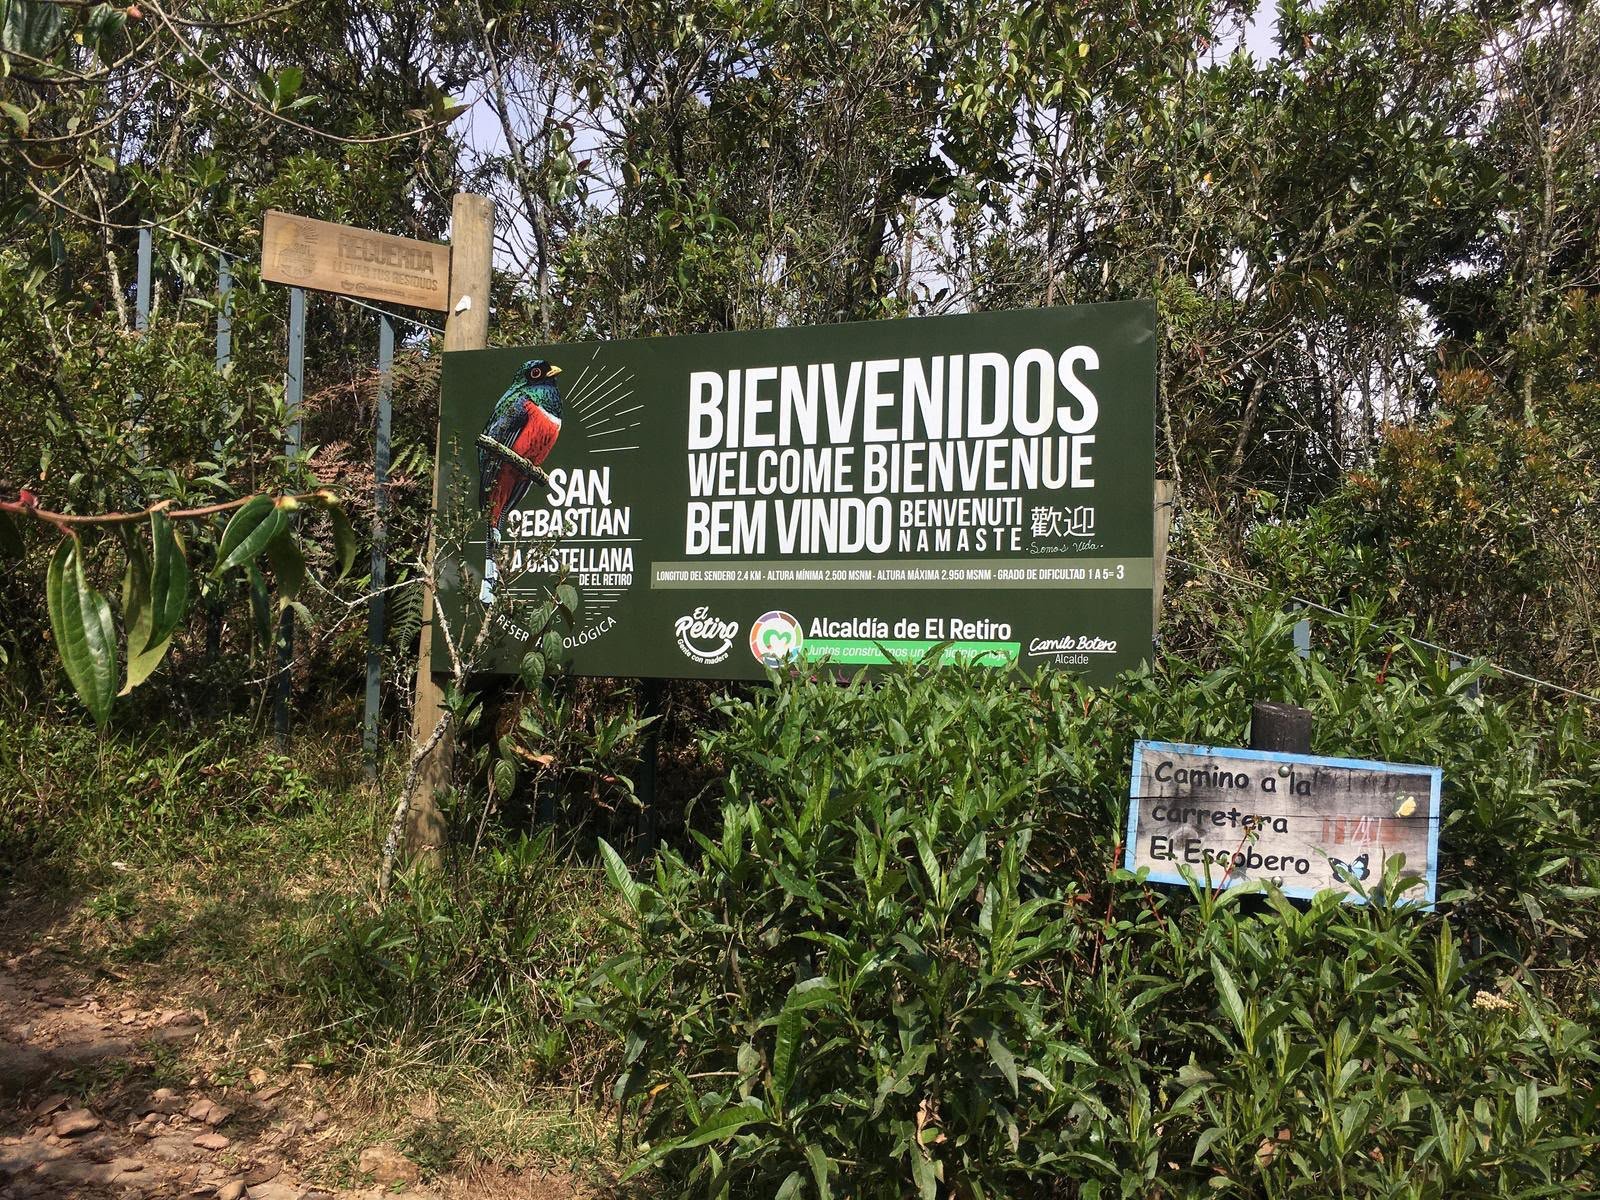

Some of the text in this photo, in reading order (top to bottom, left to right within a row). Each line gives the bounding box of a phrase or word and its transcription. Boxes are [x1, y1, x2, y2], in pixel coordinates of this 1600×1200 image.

[338, 234, 433, 274] RECUERDA
[392, 271, 438, 291] RESIDUOS
[688, 345, 1100, 450] BIENVENIDOS
[687, 435, 1096, 497] WELCOME BIENVENUE
[546, 466, 611, 507] SAN
[685, 496, 892, 555] BEM VINDO
[899, 497, 1023, 528] BENVENUTI
[1030, 505, 1096, 537] 歡迎
[898, 528, 1022, 553] NAMASTE
[579, 573, 632, 586] DE EL RETIRO
[656, 570, 689, 581] LONGITUD
[690, 570, 703, 581] DEL
[704, 570, 736, 581] SENDERO
[736, 570, 749, 581] 2.4
[750, 570, 761, 581] KM
[767, 569, 794, 581] ALTURA
[795, 568, 823, 581] MÍNIMA
[825, 569, 847, 581] 2.500
[848, 569, 872, 580] MSNM
[877, 569, 905, 580] ALTURA
[907, 568, 940, 580] MÁXIMA
[941, 569, 965, 580] 2.950
[966, 569, 992, 580] MSNM
[997, 569, 1025, 580] GRADO
[1026, 569, 1037, 580] DE
[1038, 568, 1086, 580] DIFICULTAD
[1088, 569, 1093, 579] 1
[1094, 569, 1101, 580] A
[1116, 564, 1125, 580] 3
[693, 606, 709, 620] El
[496, 614, 617, 649] RESERA OLÓGICA
[674, 615, 739, 640] Retiro
[808, 617, 1012, 641] Alcaldía de El Retiro
[808, 644, 840, 656] Juntos
[842, 645, 908, 657] construmos
[910, 648, 924, 657] un
[1029, 635, 1117, 652] Camilo Botero
[691, 654, 704, 663] con
[704, 652, 729, 665] madera
[1054, 654, 1089, 665] Alcalde
[1154, 761, 1311, 796] Camino a la
[1151, 804, 1289, 834] carretera
[1150, 835, 1311, 875] El Escobero
